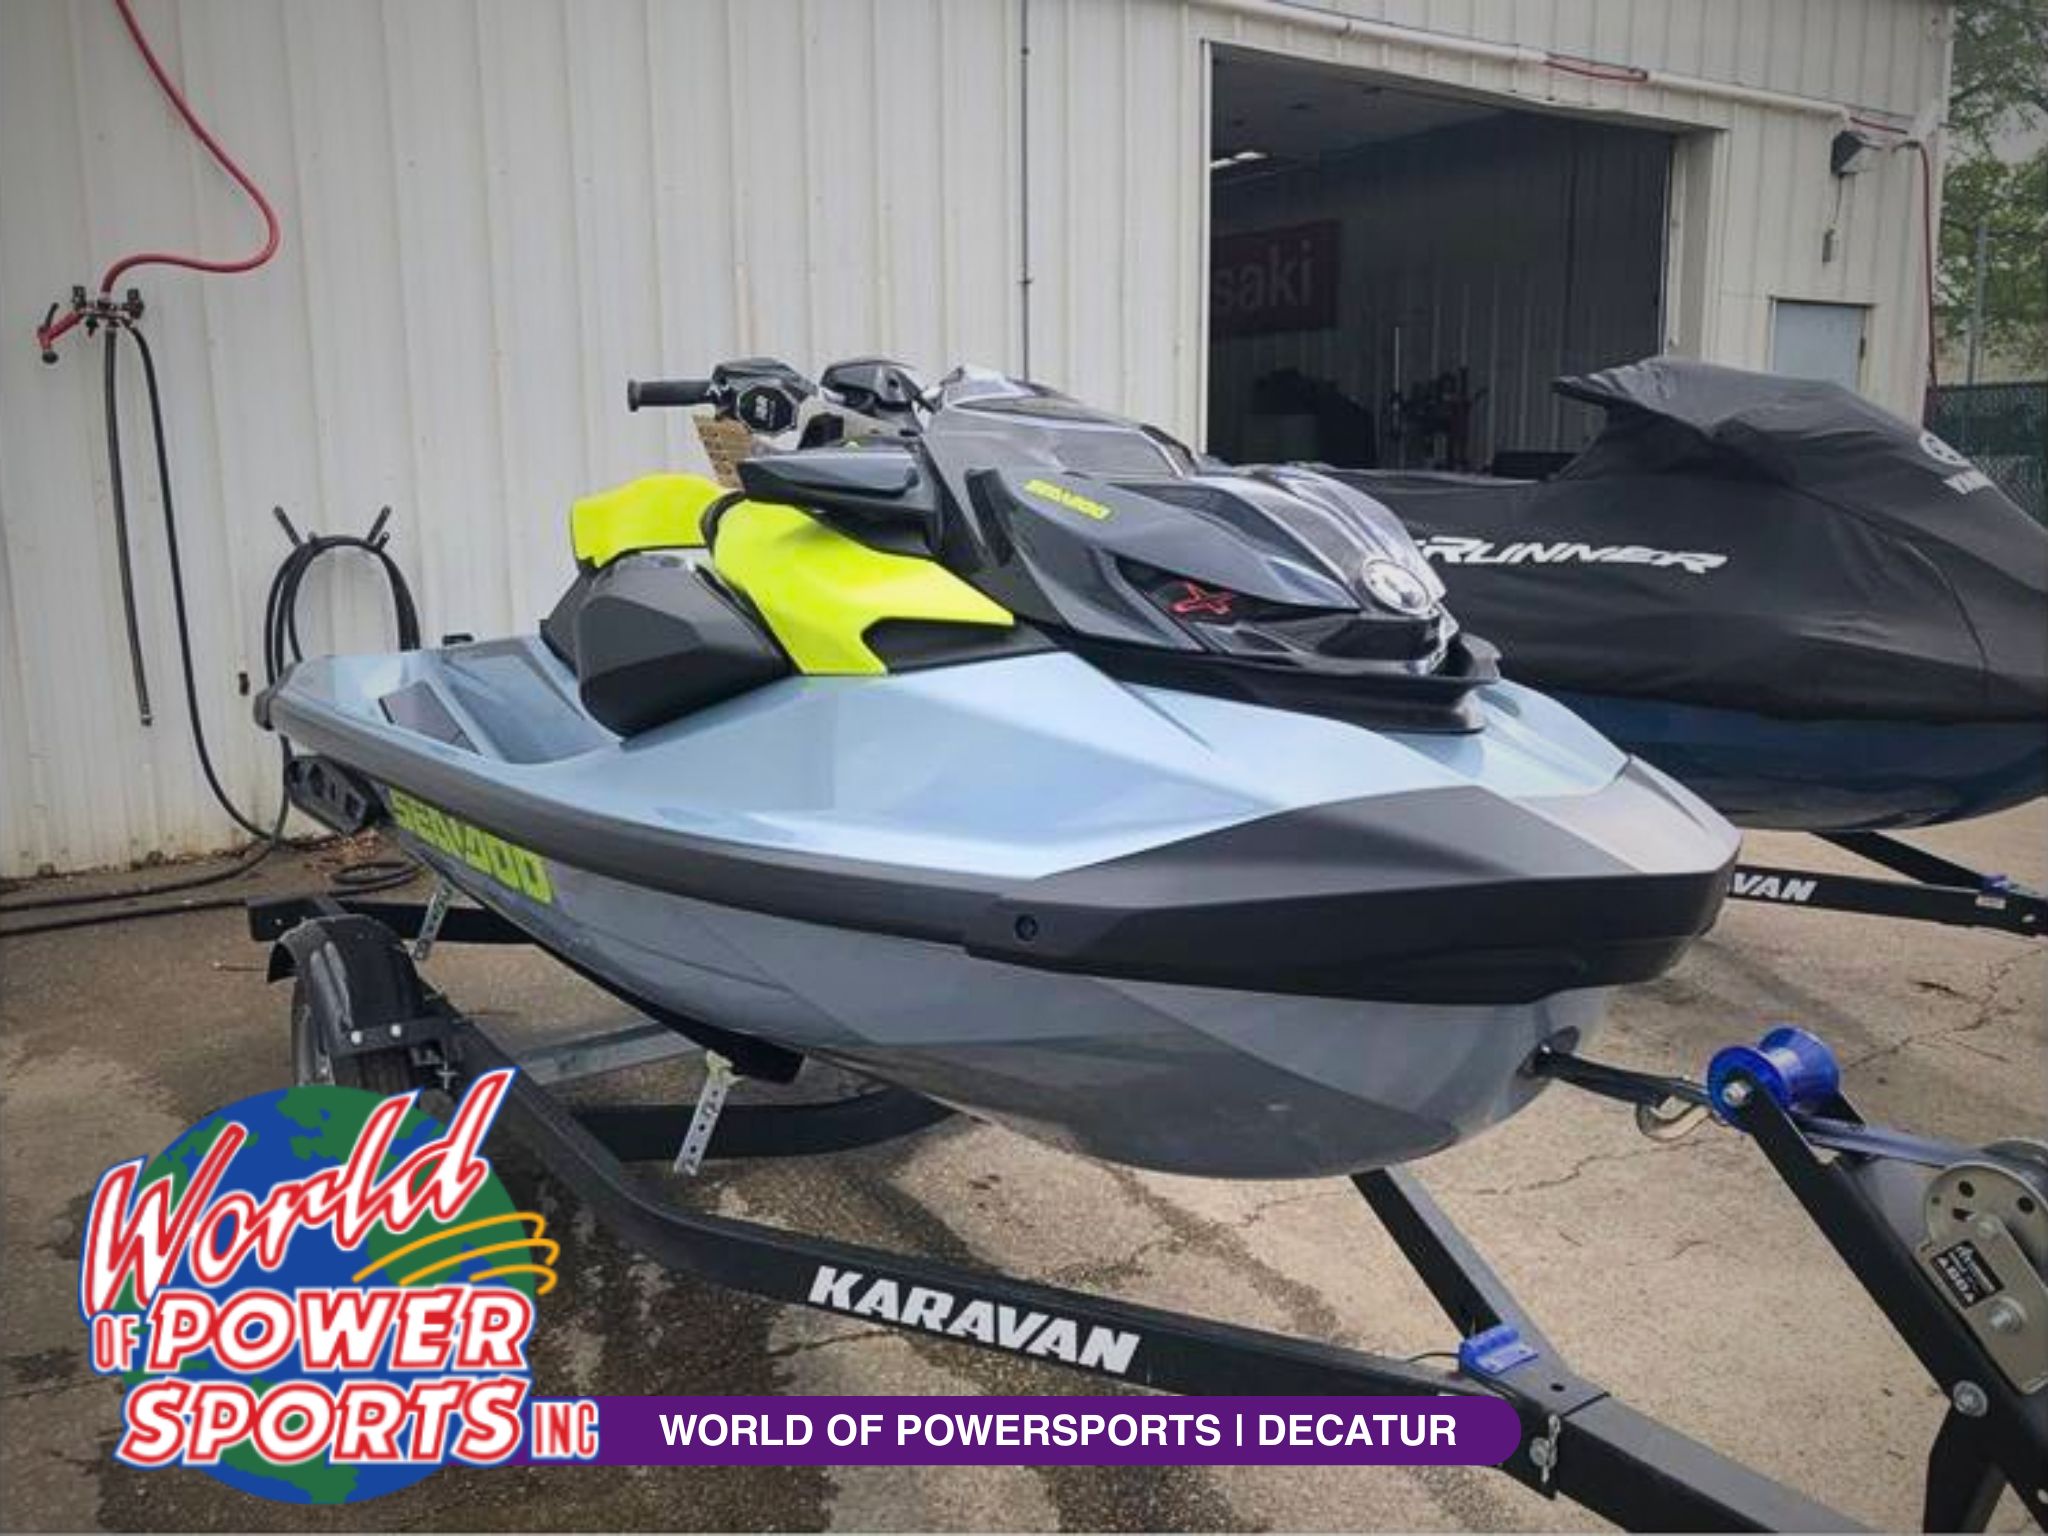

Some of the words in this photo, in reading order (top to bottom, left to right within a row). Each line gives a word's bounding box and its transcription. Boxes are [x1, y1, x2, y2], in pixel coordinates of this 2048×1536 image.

[1411, 536, 1728, 574] RUNNER
[1727, 872, 1819, 902] VAN
[808, 1265, 1141, 1374] KARAVAN
